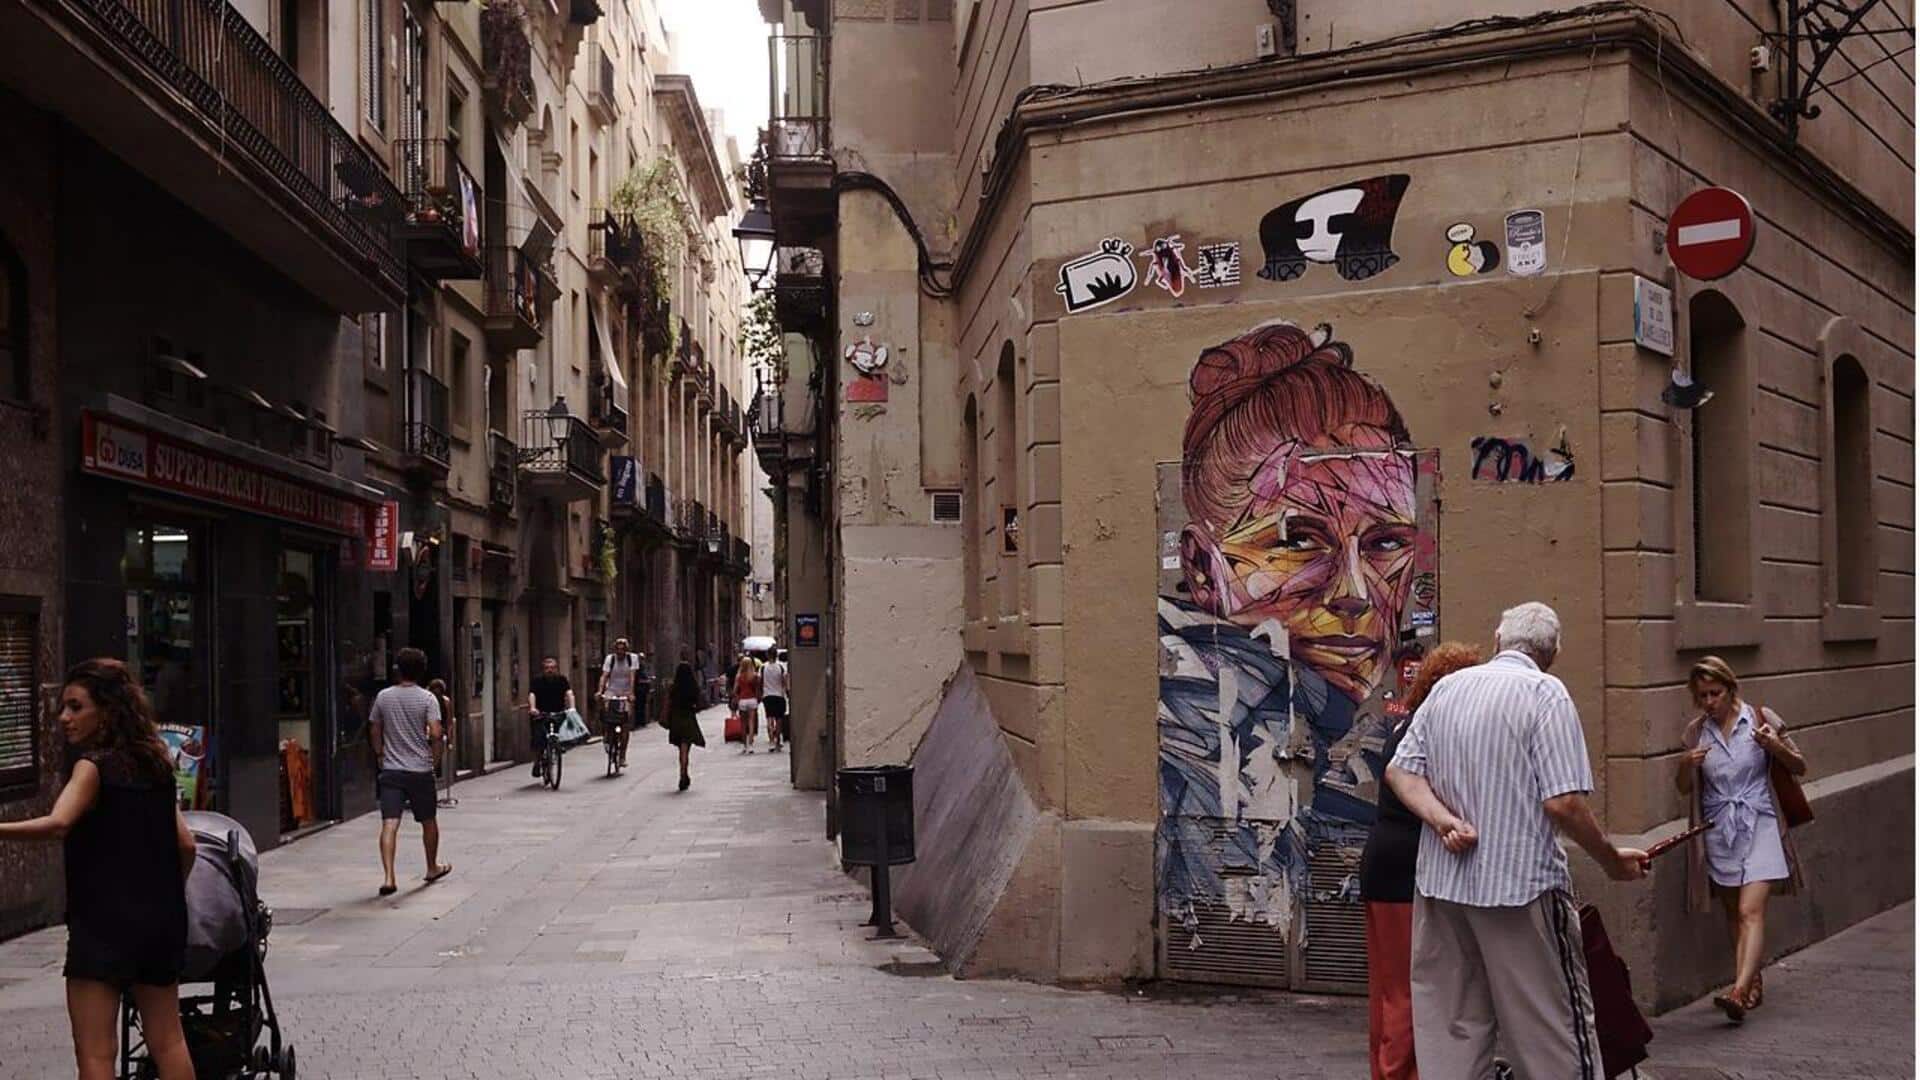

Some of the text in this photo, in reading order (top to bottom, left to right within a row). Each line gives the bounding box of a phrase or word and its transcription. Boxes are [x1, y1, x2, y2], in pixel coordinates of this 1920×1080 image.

[117, 445, 144, 470] DUSA
[153, 442, 259, 503] SUPERMERCAT
[373, 504, 390, 560] SUPER
